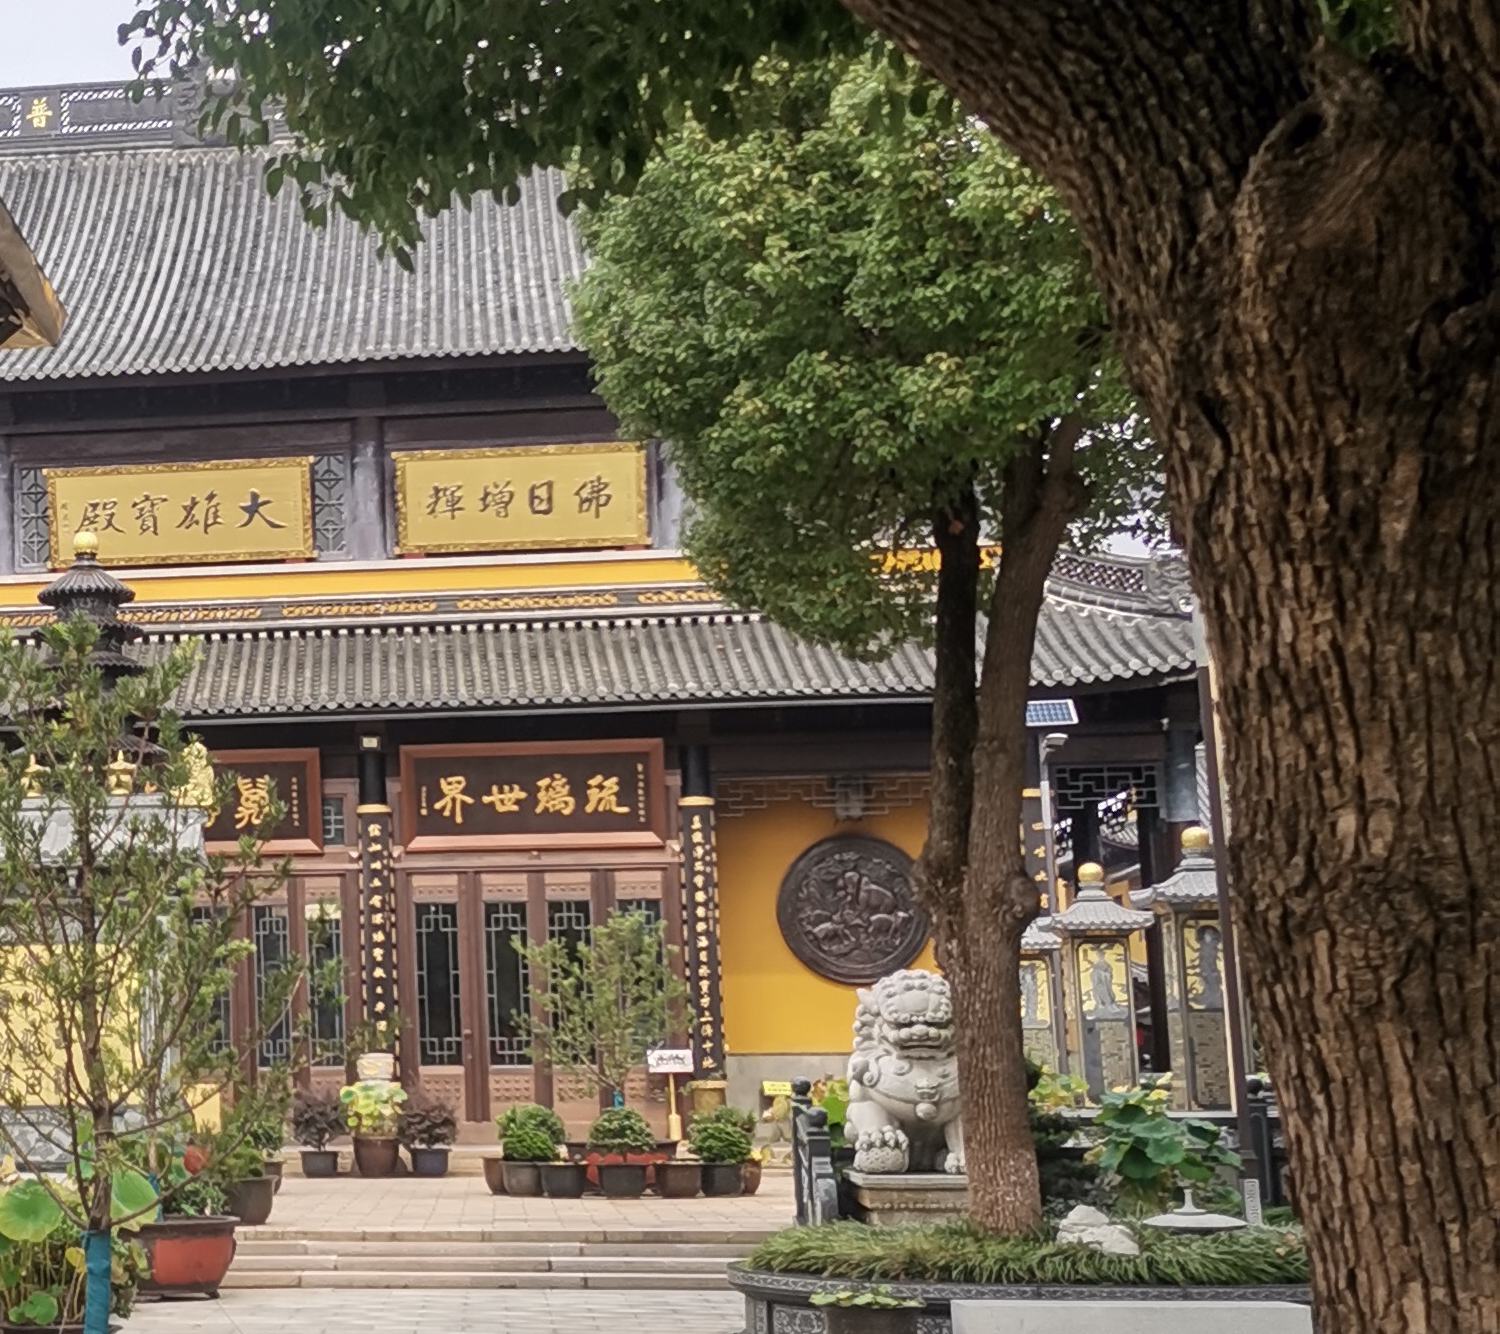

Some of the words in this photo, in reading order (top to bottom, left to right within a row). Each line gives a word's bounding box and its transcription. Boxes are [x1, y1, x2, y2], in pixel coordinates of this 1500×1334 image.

[25, 96, 53, 128] 普
[74, 487, 289, 537] 大雄寶殿
[432, 773, 632, 825] 琉璃世界
